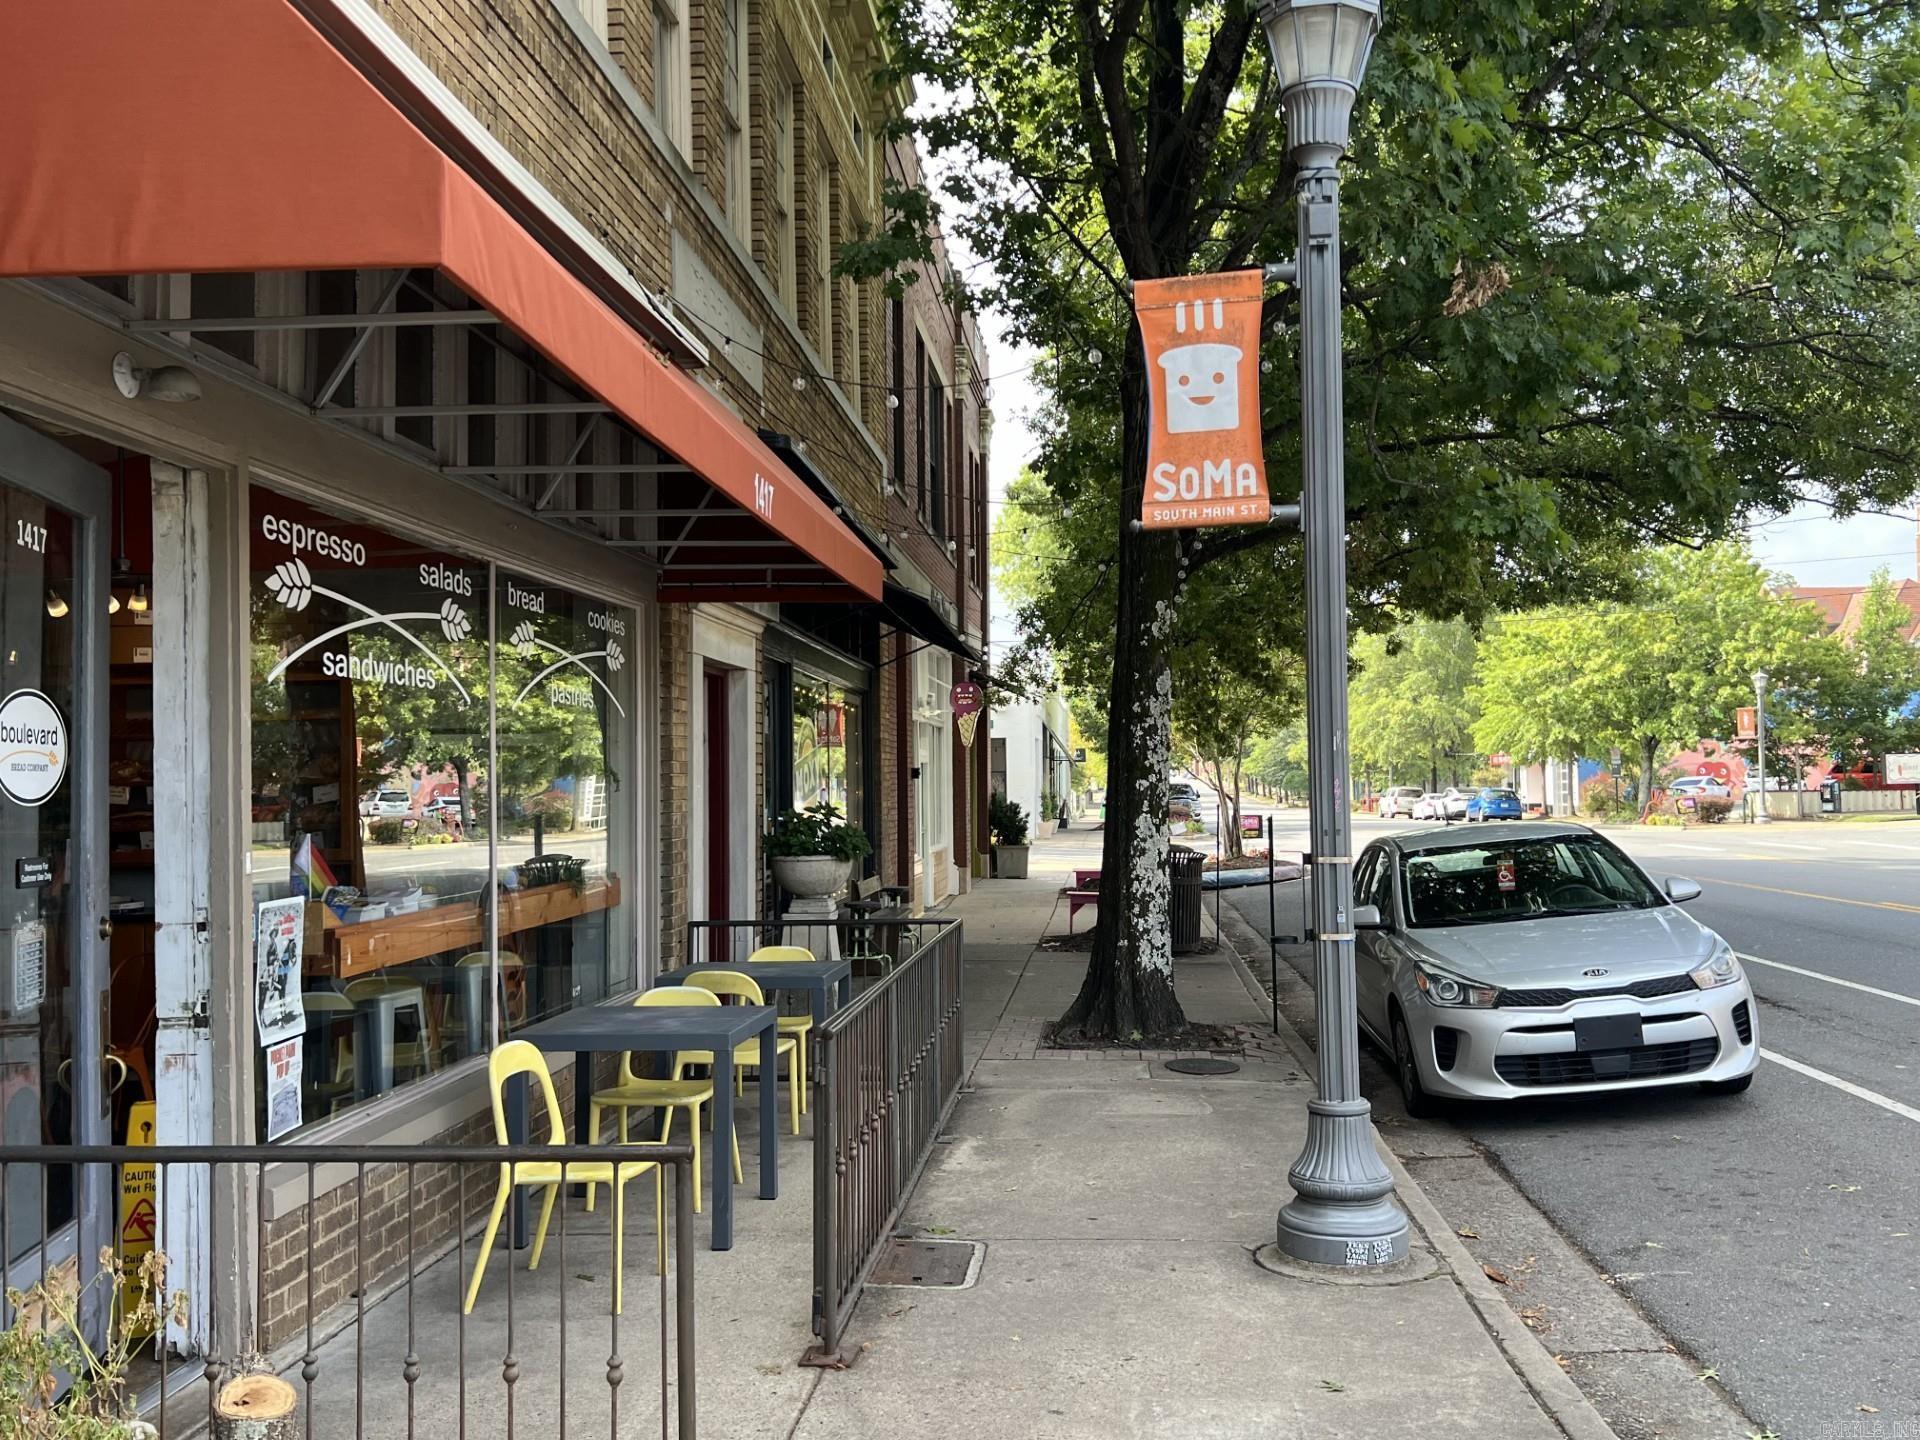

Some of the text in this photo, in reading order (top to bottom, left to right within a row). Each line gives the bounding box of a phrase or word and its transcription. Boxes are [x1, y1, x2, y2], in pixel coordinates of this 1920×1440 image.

[755, 472, 774, 520] 1417
[1154, 504, 1263, 521] SOUTH MAIN ST.
[17, 519, 47, 554] 1417
[262, 514, 366, 566] espresso
[419, 562, 473, 597] salads
[507, 581, 544, 614] bread
[587, 611, 625, 636] cookies
[322, 651, 436, 689] sandwiches
[550, 675, 594, 709] pastries
[0, 721, 58, 746] boulevard
[123, 1182, 156, 1194] Wet Flo
[124, 1169, 156, 1182] CAUTIO
